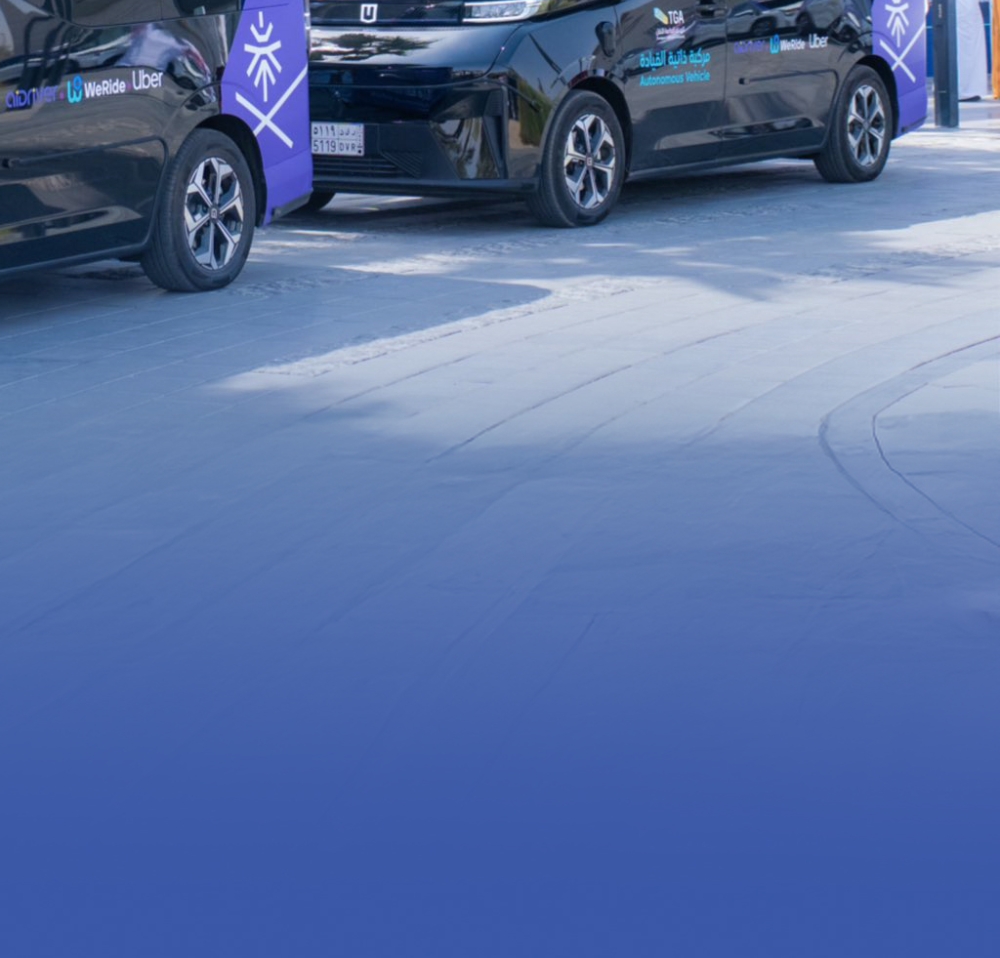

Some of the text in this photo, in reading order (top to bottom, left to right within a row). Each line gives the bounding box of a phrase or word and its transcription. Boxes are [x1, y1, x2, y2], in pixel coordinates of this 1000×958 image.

[667, 9, 685, 24] TGA
[808, 33, 829, 49] Uber
[640, 47, 711, 72] مركبة ذاتية القيادة
[84, 75, 126, 98] WeRide
[132, 70, 164, 91] Uber
[640, 70, 711, 87] Autonomous Vehicle
[313, 140, 337, 153] 5119
